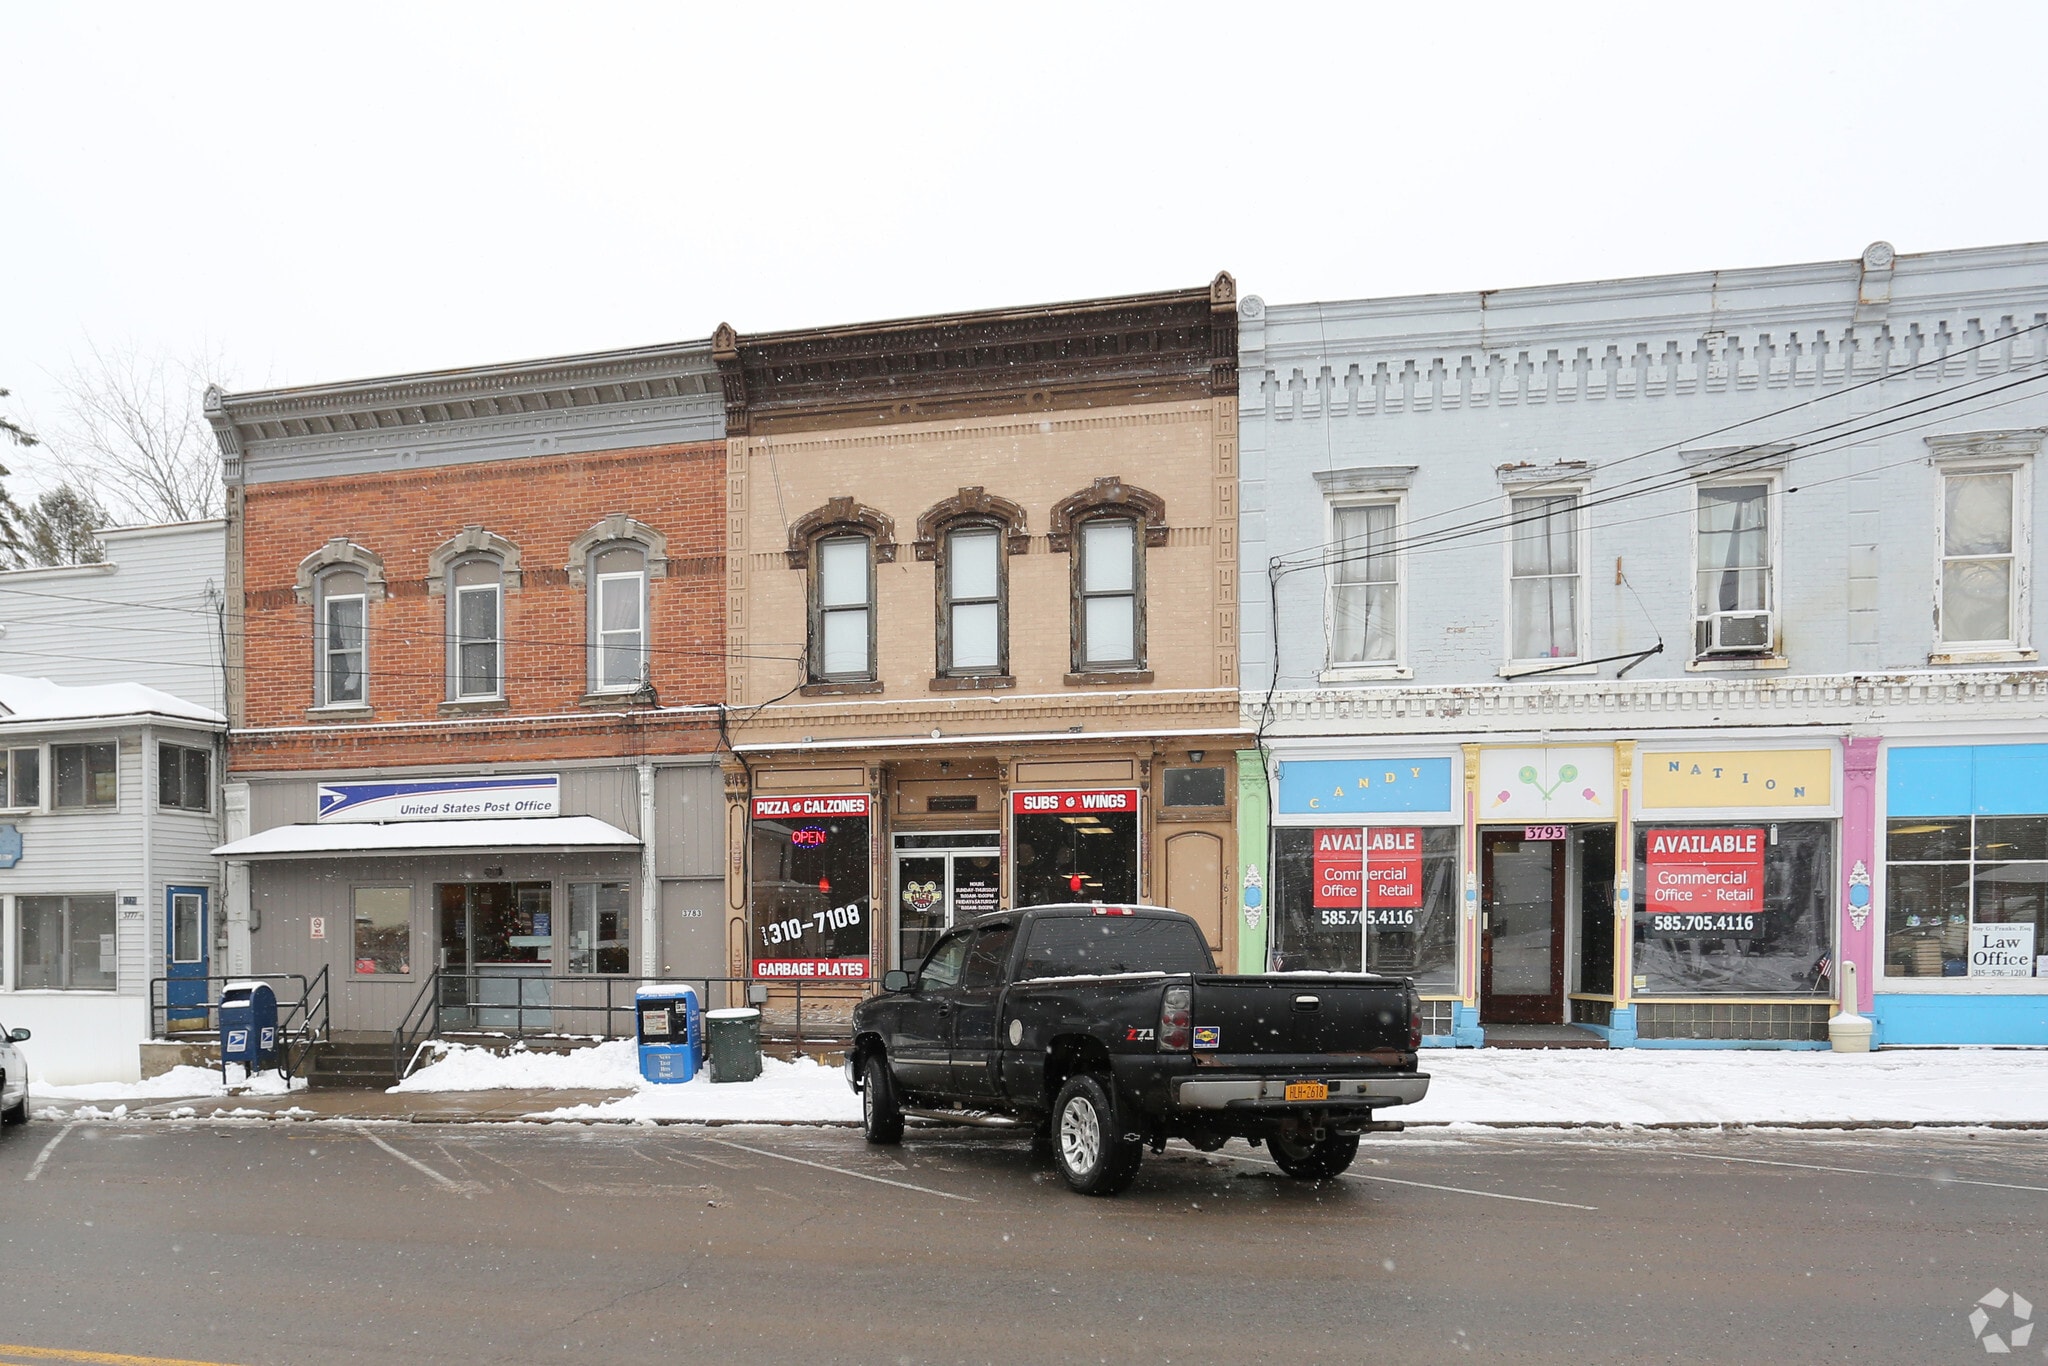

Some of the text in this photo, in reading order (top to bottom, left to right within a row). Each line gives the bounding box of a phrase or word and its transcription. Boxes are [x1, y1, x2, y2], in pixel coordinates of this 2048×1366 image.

[1668, 761, 1805, 798] NATION
[1309, 767, 1421, 808] CANDY
[400, 800, 552, 815] United States Post Office
[756, 799, 865, 815] PIZZA CALZONES
[1023, 794, 1127, 810] SUBS WINGS
[792, 831, 826, 844] OPEN
[1527, 826, 1563, 839] 3793
[1653, 835, 1757, 853] AVAILABLE
[1658, 870, 1747, 885] Commercial
[1321, 884, 1357, 897] Office
[1379, 884, 1413, 896] Retail
[1654, 888, 1693, 901] Office
[1716, 888, 1754, 901] Retail
[768, 904, 860, 944] 310-7108
[1321, 910, 1414, 925] 585.75.4116
[1654, 915, 1754, 931] 585.705.4116
[760, 926, 769, 946] 315
[1982, 934, 2021, 949] Law
[1973, 951, 2029, 966] Office
[758, 962, 864, 976] GARBAGE PLATES
[1126, 1028, 1154, 1040] Z71
